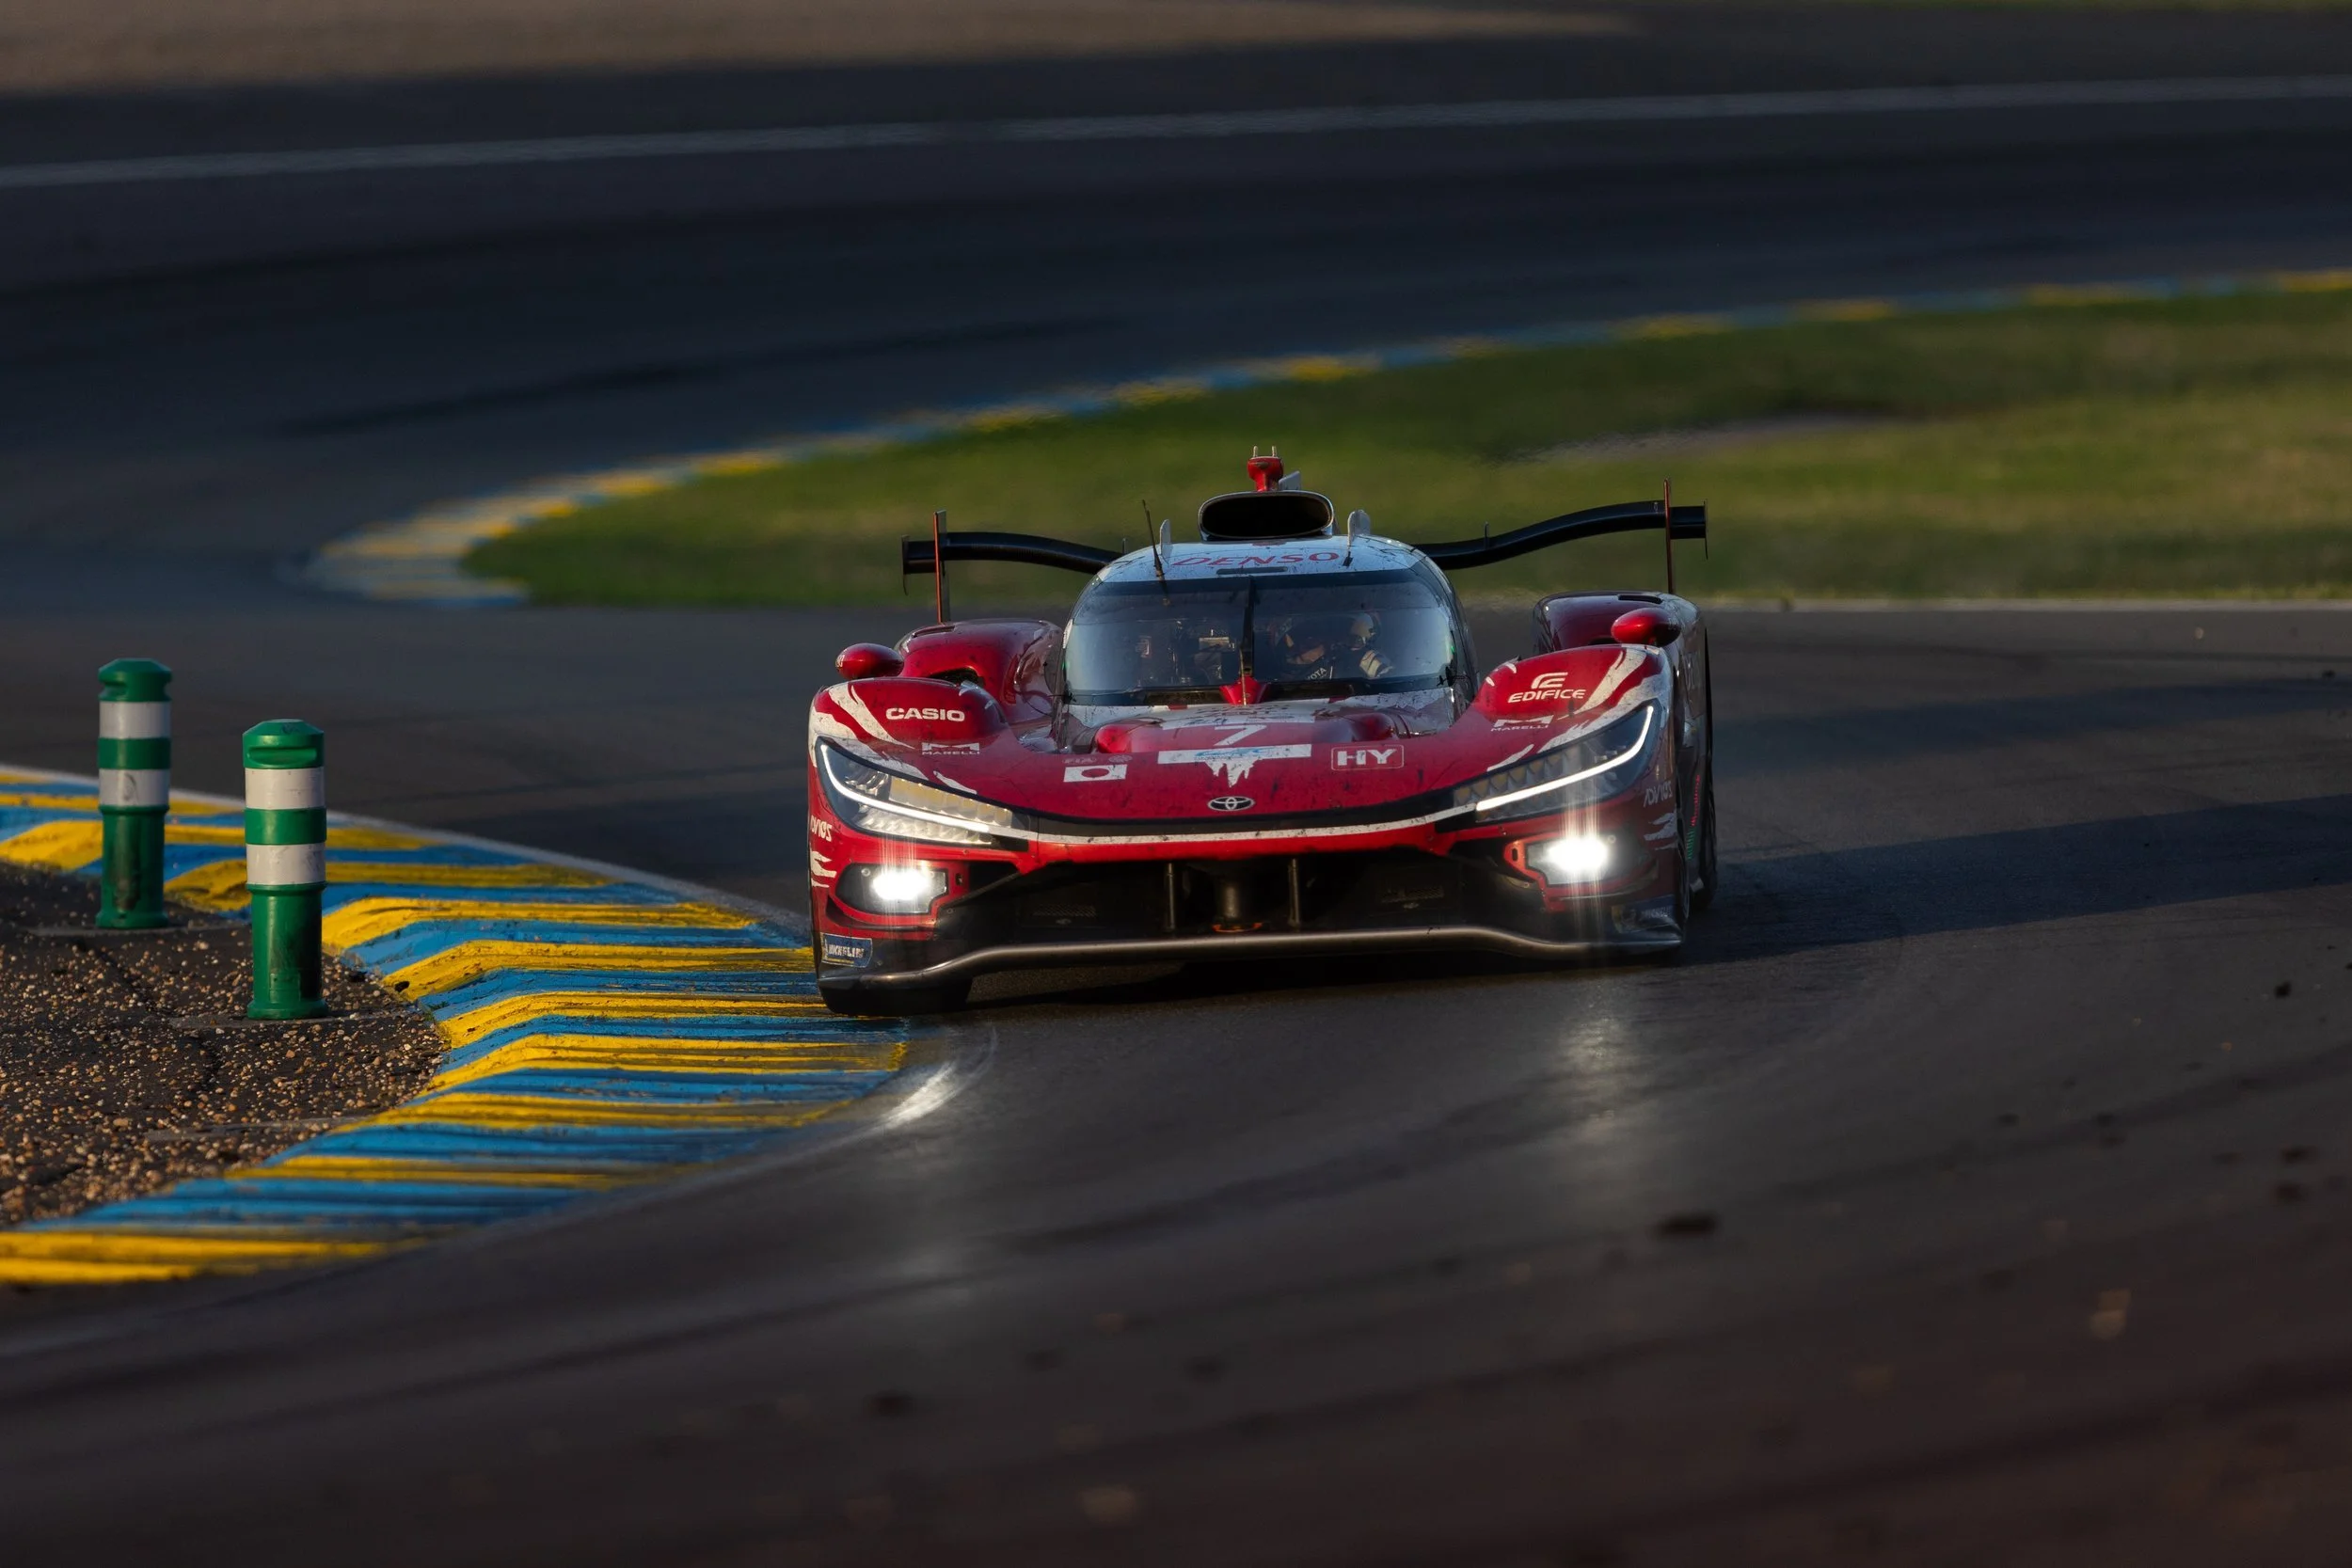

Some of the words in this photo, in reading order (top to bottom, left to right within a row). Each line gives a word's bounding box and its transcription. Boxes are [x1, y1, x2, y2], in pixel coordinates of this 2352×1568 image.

[1172, 552, 1340, 565] DENSO
[1507, 689, 1586, 703] EDIFICE
[885, 707, 965, 722] CASIO
[1214, 724, 1267, 746] 7
[1337, 748, 1397, 767] HY
